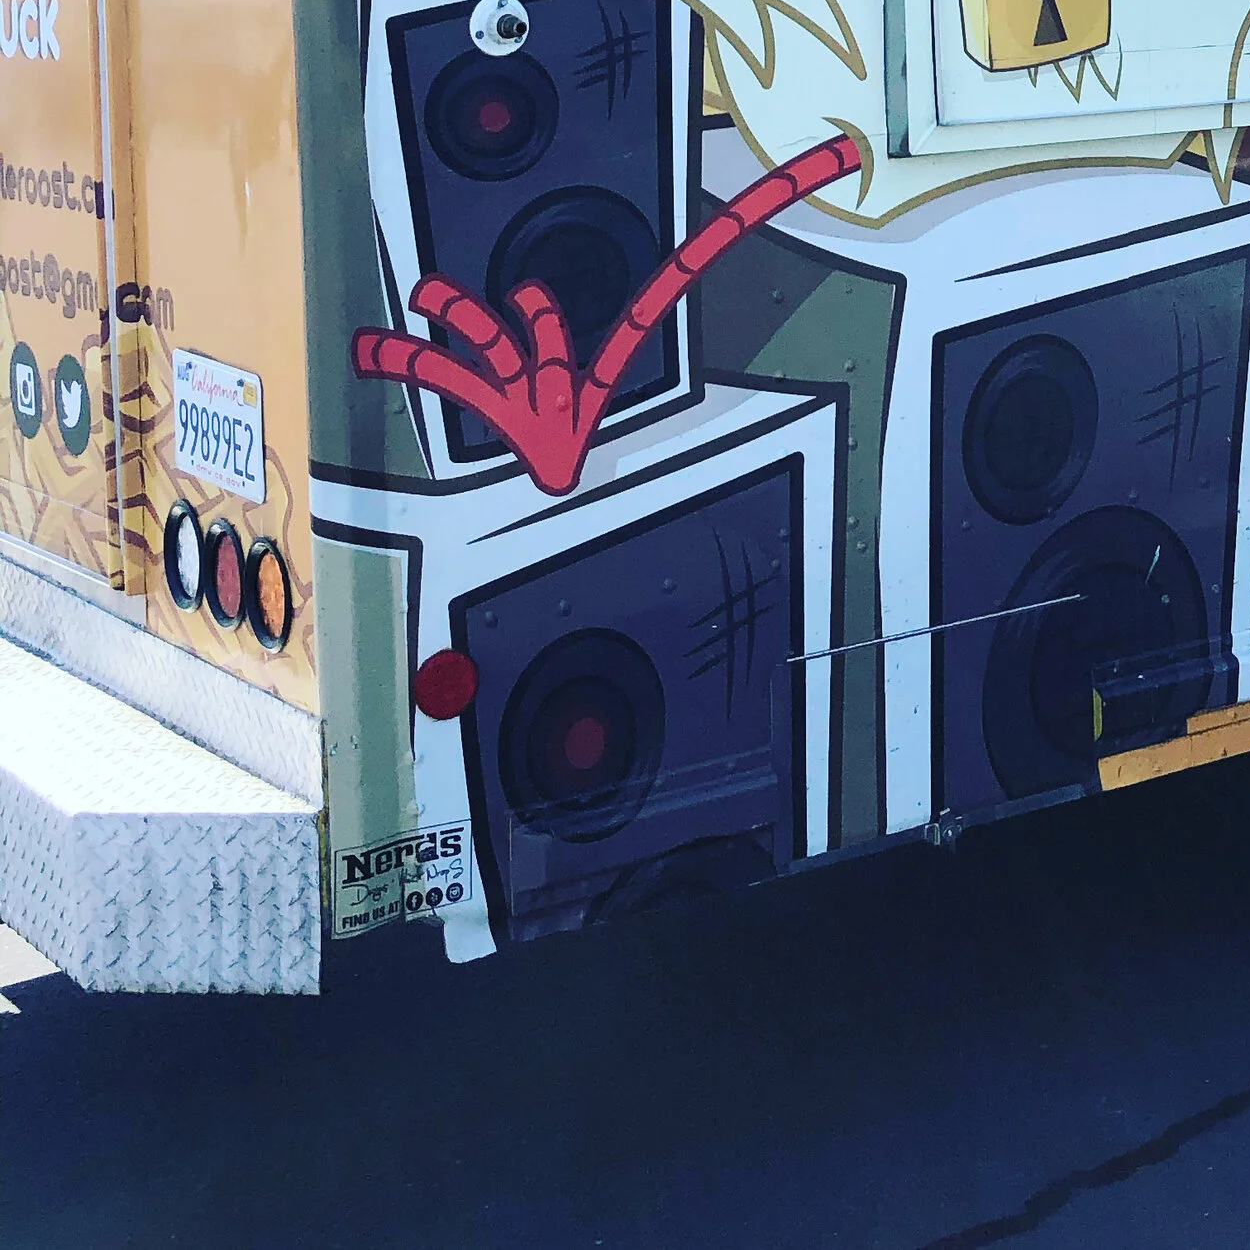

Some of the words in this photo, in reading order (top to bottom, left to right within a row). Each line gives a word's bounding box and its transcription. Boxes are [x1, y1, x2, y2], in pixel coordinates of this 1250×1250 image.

[179, 399, 255, 482] 99899E2
[342, 827, 464, 885] Nerds
[342, 912, 370, 929] FIND
[372, 905, 386, 920] US
[388, 900, 401, 915] AT
